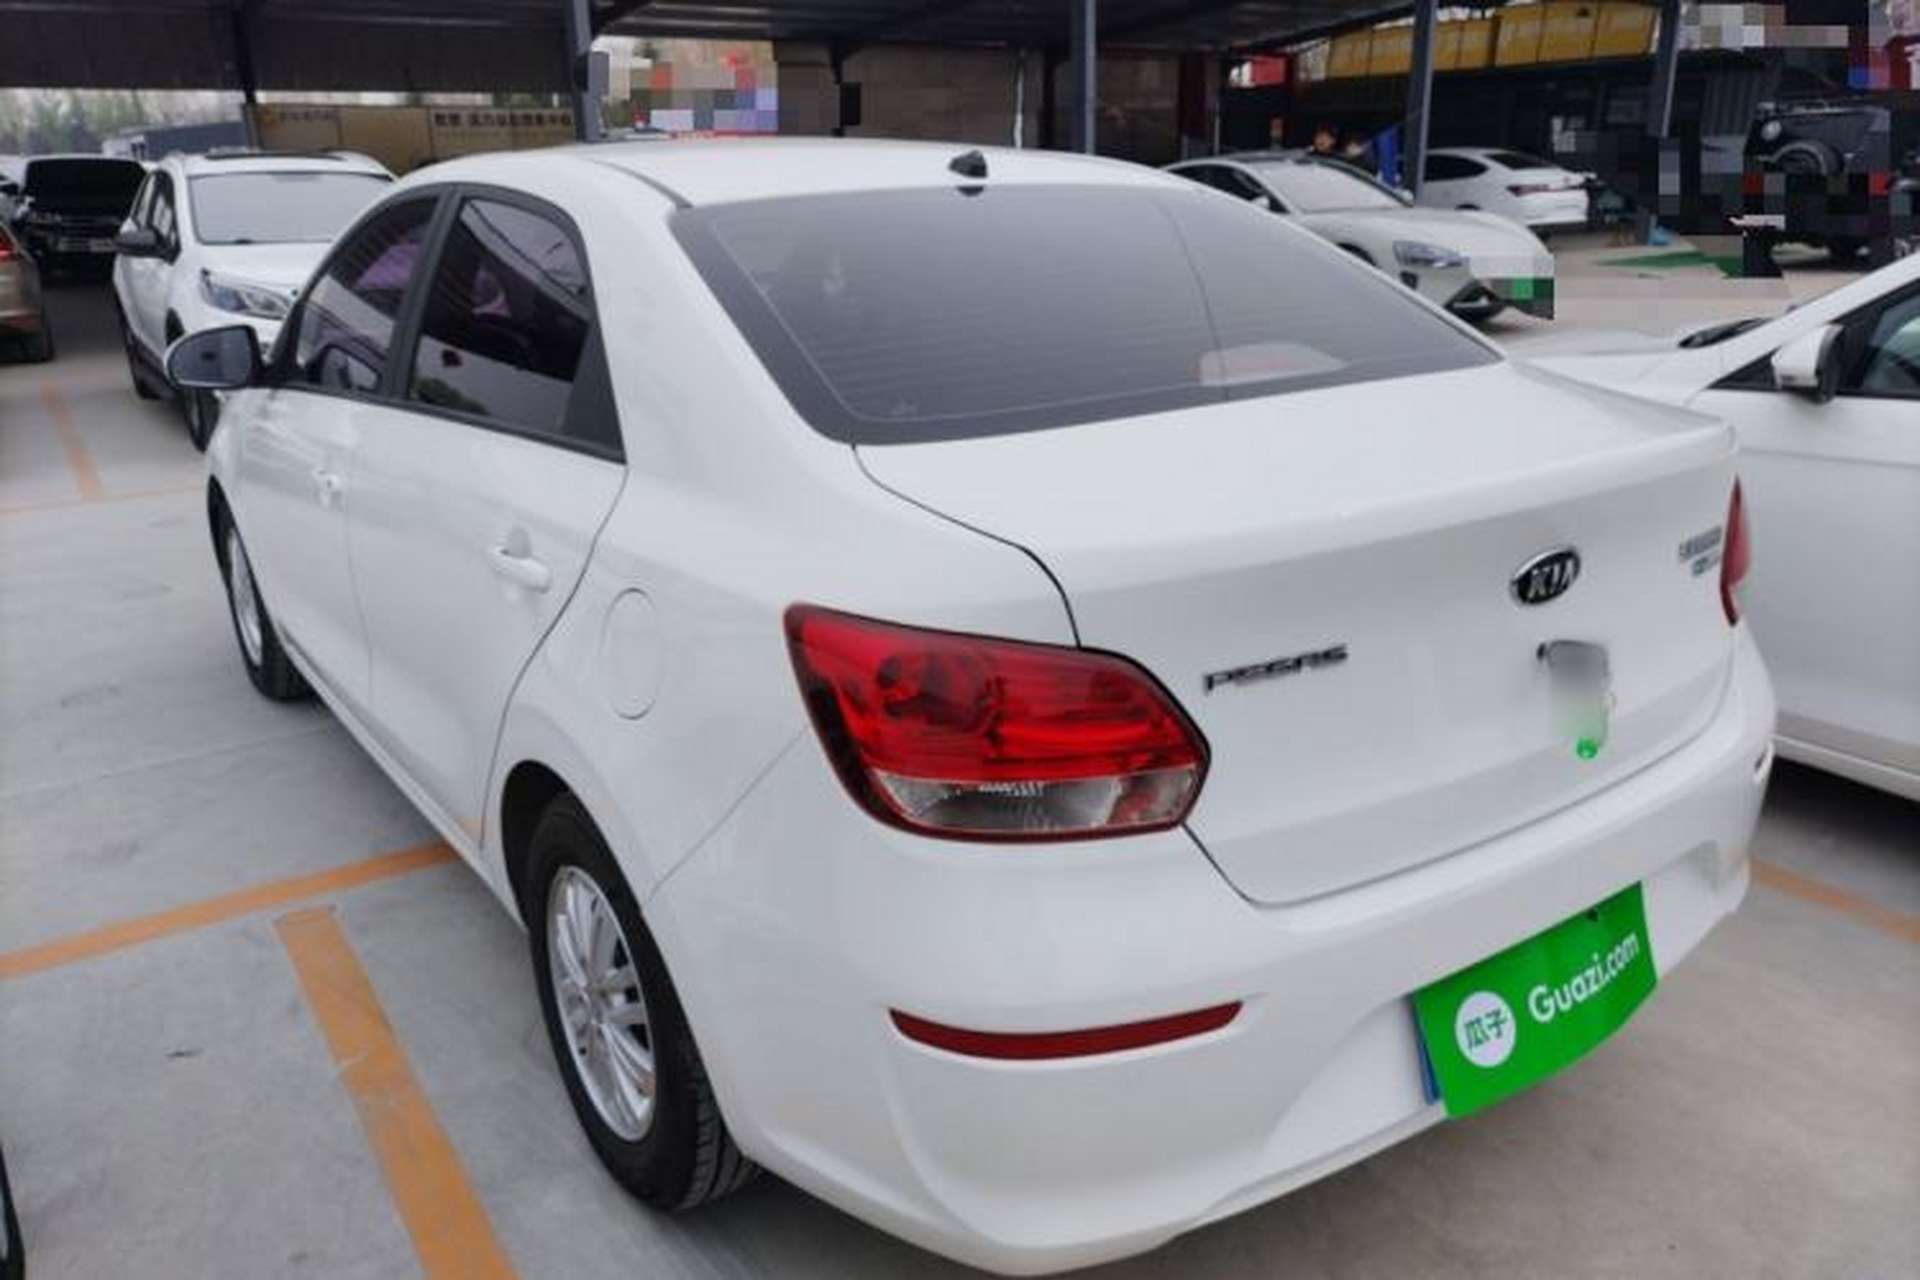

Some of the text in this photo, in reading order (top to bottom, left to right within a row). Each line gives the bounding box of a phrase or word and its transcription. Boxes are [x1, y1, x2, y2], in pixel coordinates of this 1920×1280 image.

[1524, 556, 1575, 600] KIA
[1527, 932, 1639, 1023] Guazi.com
[1464, 1009, 1508, 1050] 瓜子
